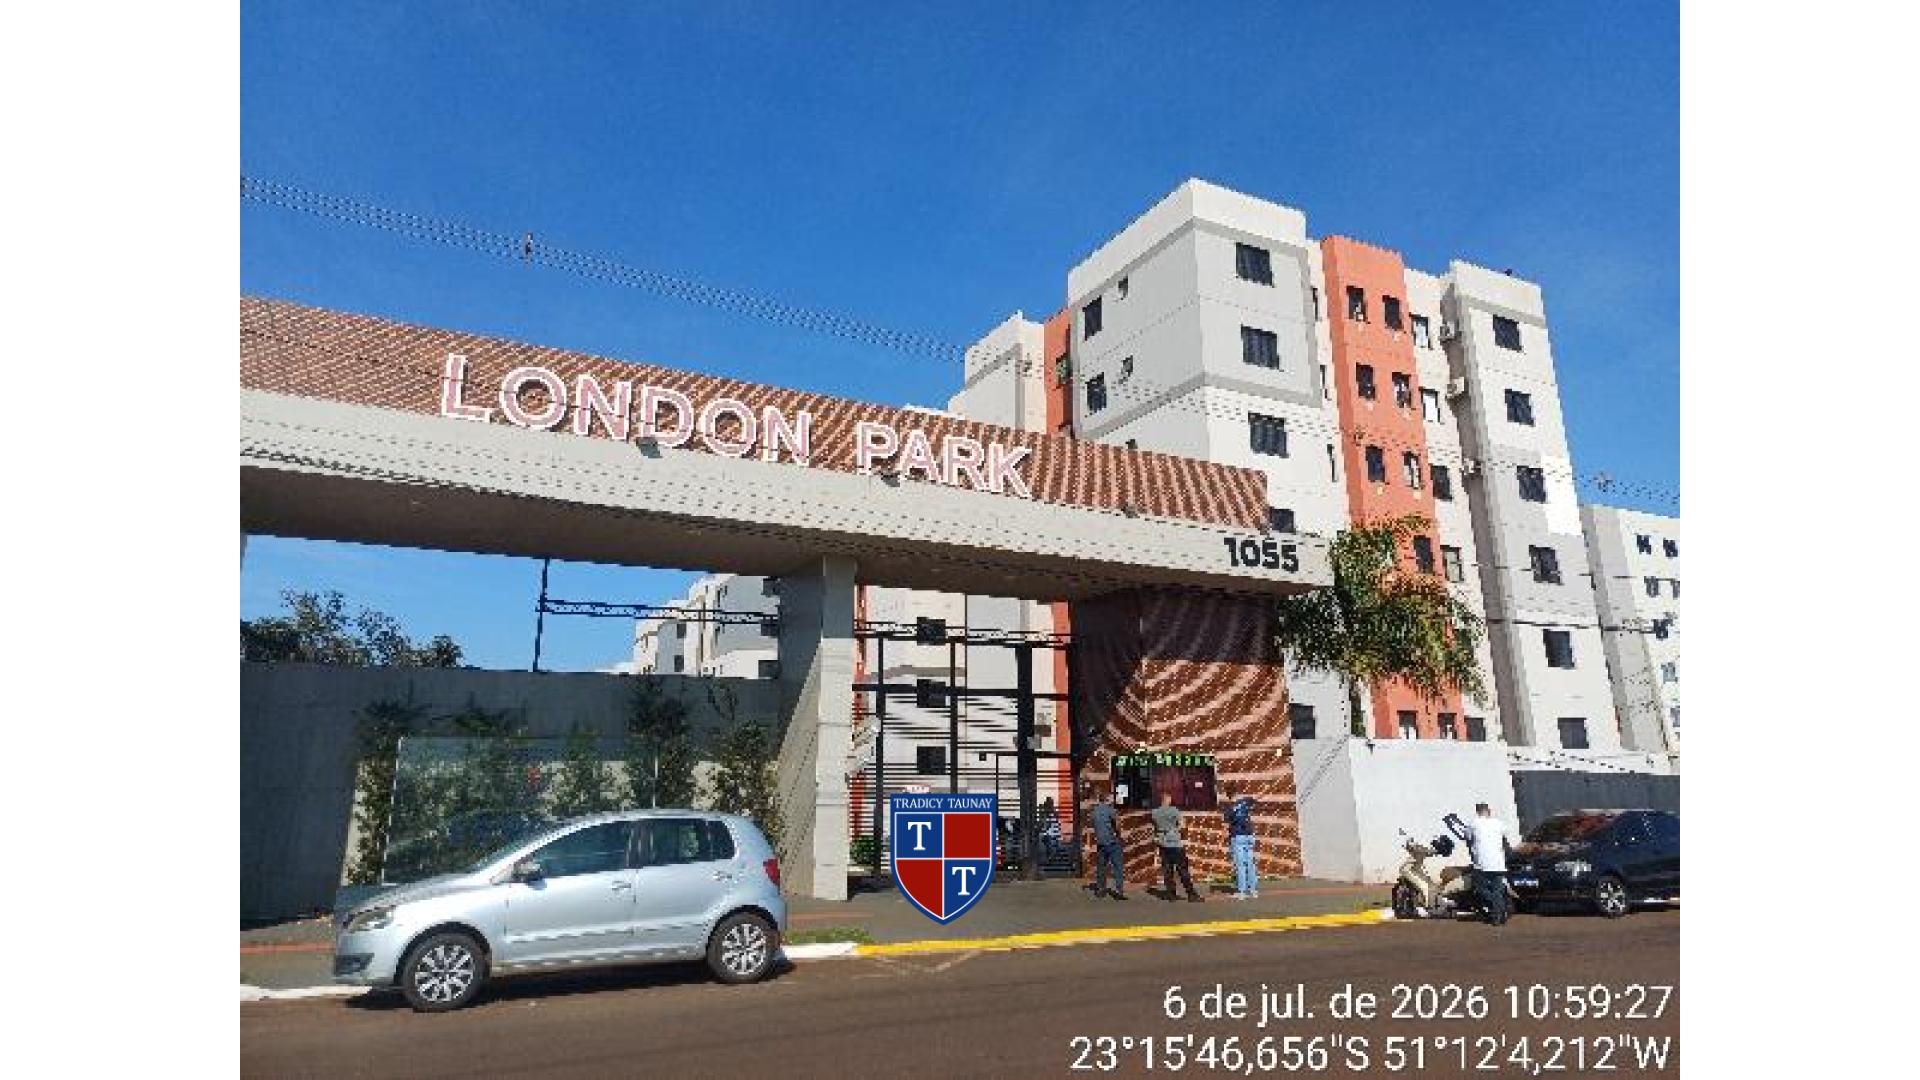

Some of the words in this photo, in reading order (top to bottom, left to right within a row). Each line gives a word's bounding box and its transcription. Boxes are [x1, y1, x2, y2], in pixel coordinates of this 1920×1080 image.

[441, 353, 809, 467] LONDON
[857, 421, 1032, 499] PARK
[1224, 538, 1299, 573] 1055
